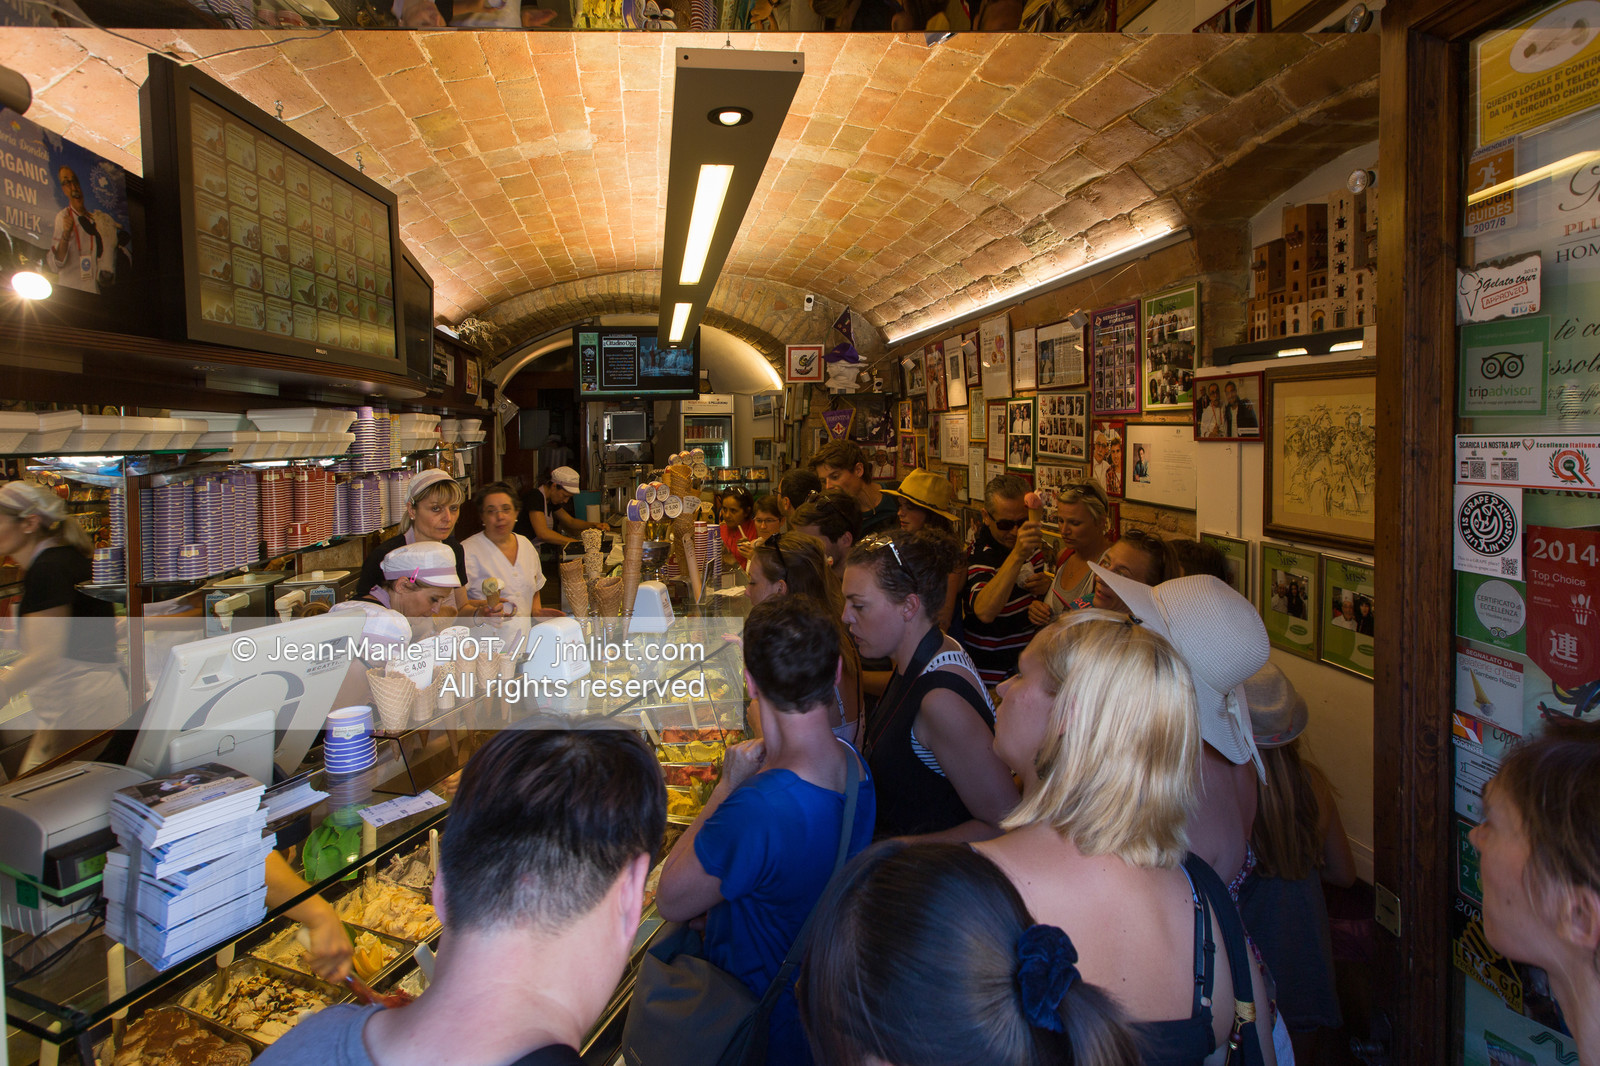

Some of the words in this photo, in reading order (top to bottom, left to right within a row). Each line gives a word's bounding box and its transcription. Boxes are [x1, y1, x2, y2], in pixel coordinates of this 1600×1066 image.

[1487, 91, 1517, 110] QUESTO
[1520, 76, 1552, 96] LOCALE
[1489, 109, 1500, 119] DA
[1502, 103, 1513, 114] UN
[1515, 87, 1552, 108] SISTEMA
[1555, 82, 1563, 93] DI
[1512, 110, 1518, 119] A
[1520, 95, 1560, 116] CIRCUITO
[1563, 79, 1599, 99] CHIUSO
[4, 178, 37, 205] RAW
[5, 206, 41, 233] MILK
[1468, 202, 1512, 222] GUIDES
[1473, 216, 1506, 235] 2007/8
[1483, 278, 1514, 292] Gelato
[1516, 274, 1537, 283] tour
[1485, 285, 1525, 306] APPROVED
[1102, 313, 1118, 321] SERGIO
[1109, 314, 1134, 324] FIORENTINA
[1469, 384, 1533, 400] tripadvisor
[1459, 441, 1480, 449] SCARICA
[1481, 441, 1488, 449] LA
[1489, 441, 1509, 449] NOSTRA
[1510, 441, 1521, 449] APP
[1464, 495, 1490, 516] GRAPE
[1462, 517, 1469, 527] IS
[1489, 543, 1500, 552] IN
[1497, 503, 1513, 547] TUSCANY
[1463, 528, 1479, 548] LIFE
[1280, 556, 1298, 566] MISS
[1532, 538, 1599, 567] 2014
[1345, 573, 1367, 583] MISS
[1532, 570, 1550, 582] Top
[1552, 573, 1586, 588] Choice
[1476, 594, 1515, 609] CERTIFICATO
[1479, 602, 1519, 618] ECCELLENZA
[1549, 629, 1579, 664] 連
[411, 660, 427, 672] 4,00
[1466, 649, 1503, 665] SEGNALATO
[1503, 660, 1514, 669] DA
[1474, 669, 1499, 682] Gambero
[1499, 678, 1517, 689] Rosso
[1455, 898, 1482, 922] 200
[1499, 974, 1521, 999] GO
